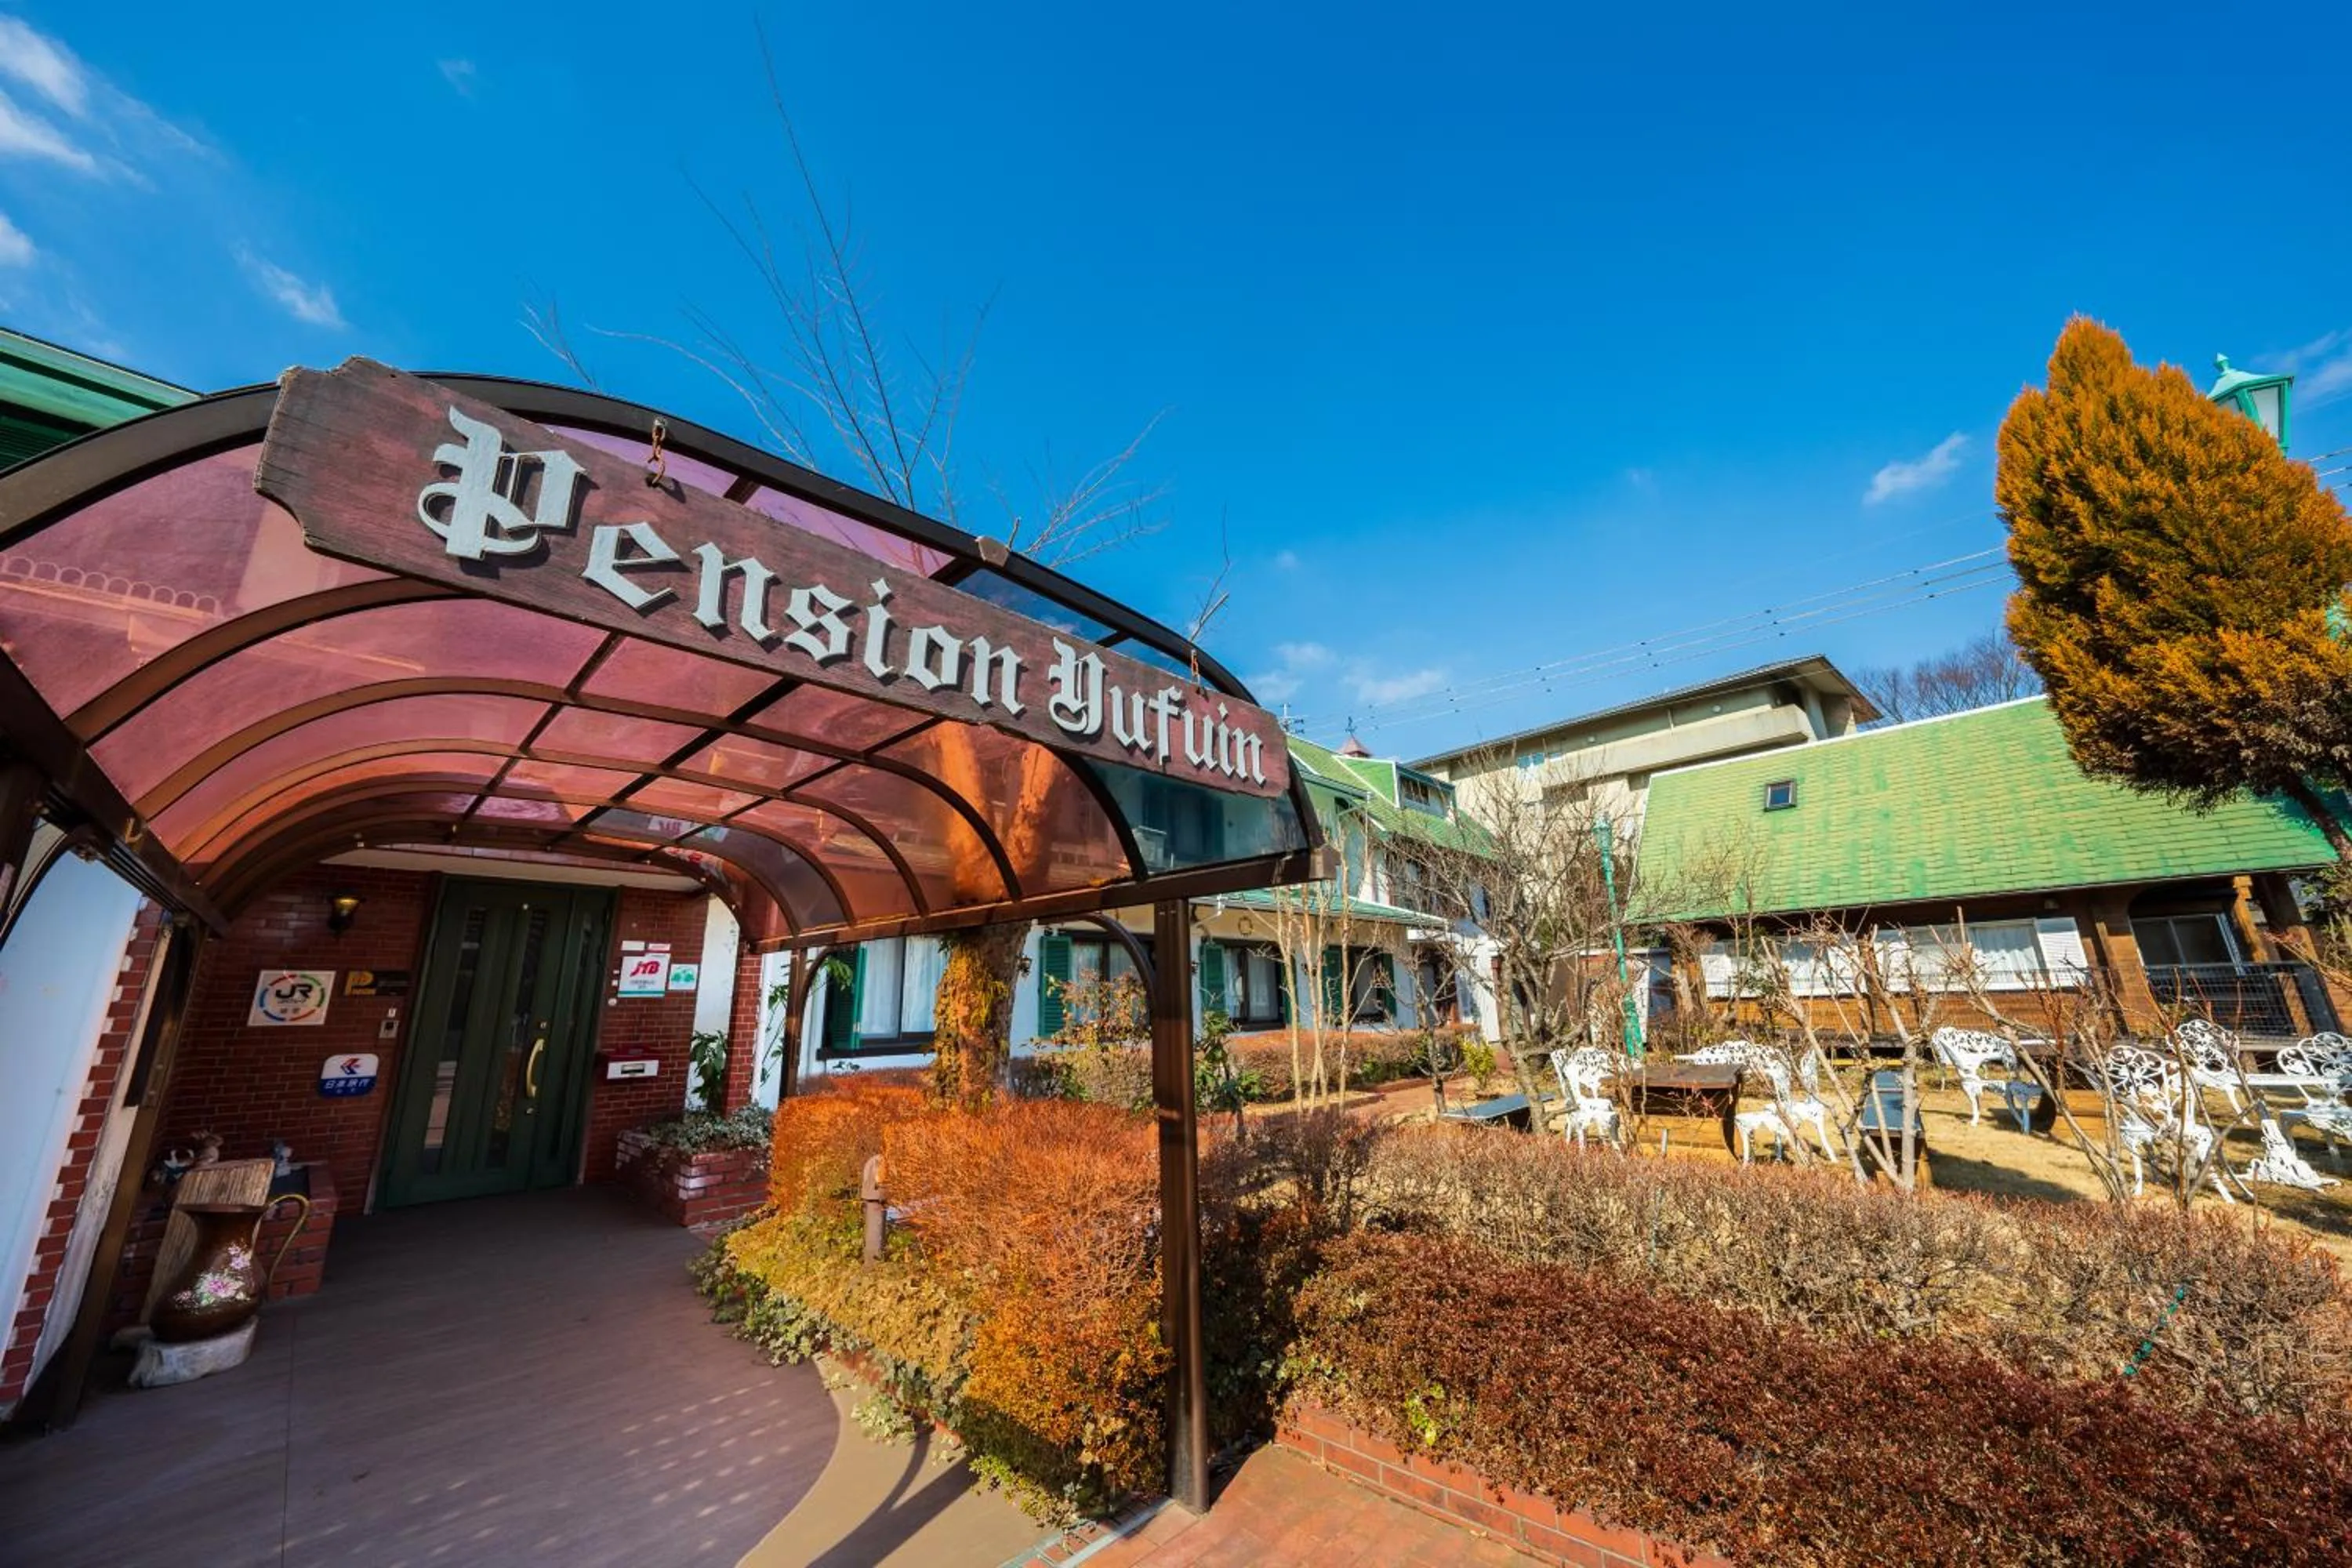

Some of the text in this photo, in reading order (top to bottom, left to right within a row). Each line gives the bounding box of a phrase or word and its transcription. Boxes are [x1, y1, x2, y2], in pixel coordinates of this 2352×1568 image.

[417, 405, 1266, 786] Pension Yufuin
[630, 960, 661, 978] JTB
[275, 983, 313, 998] JR
